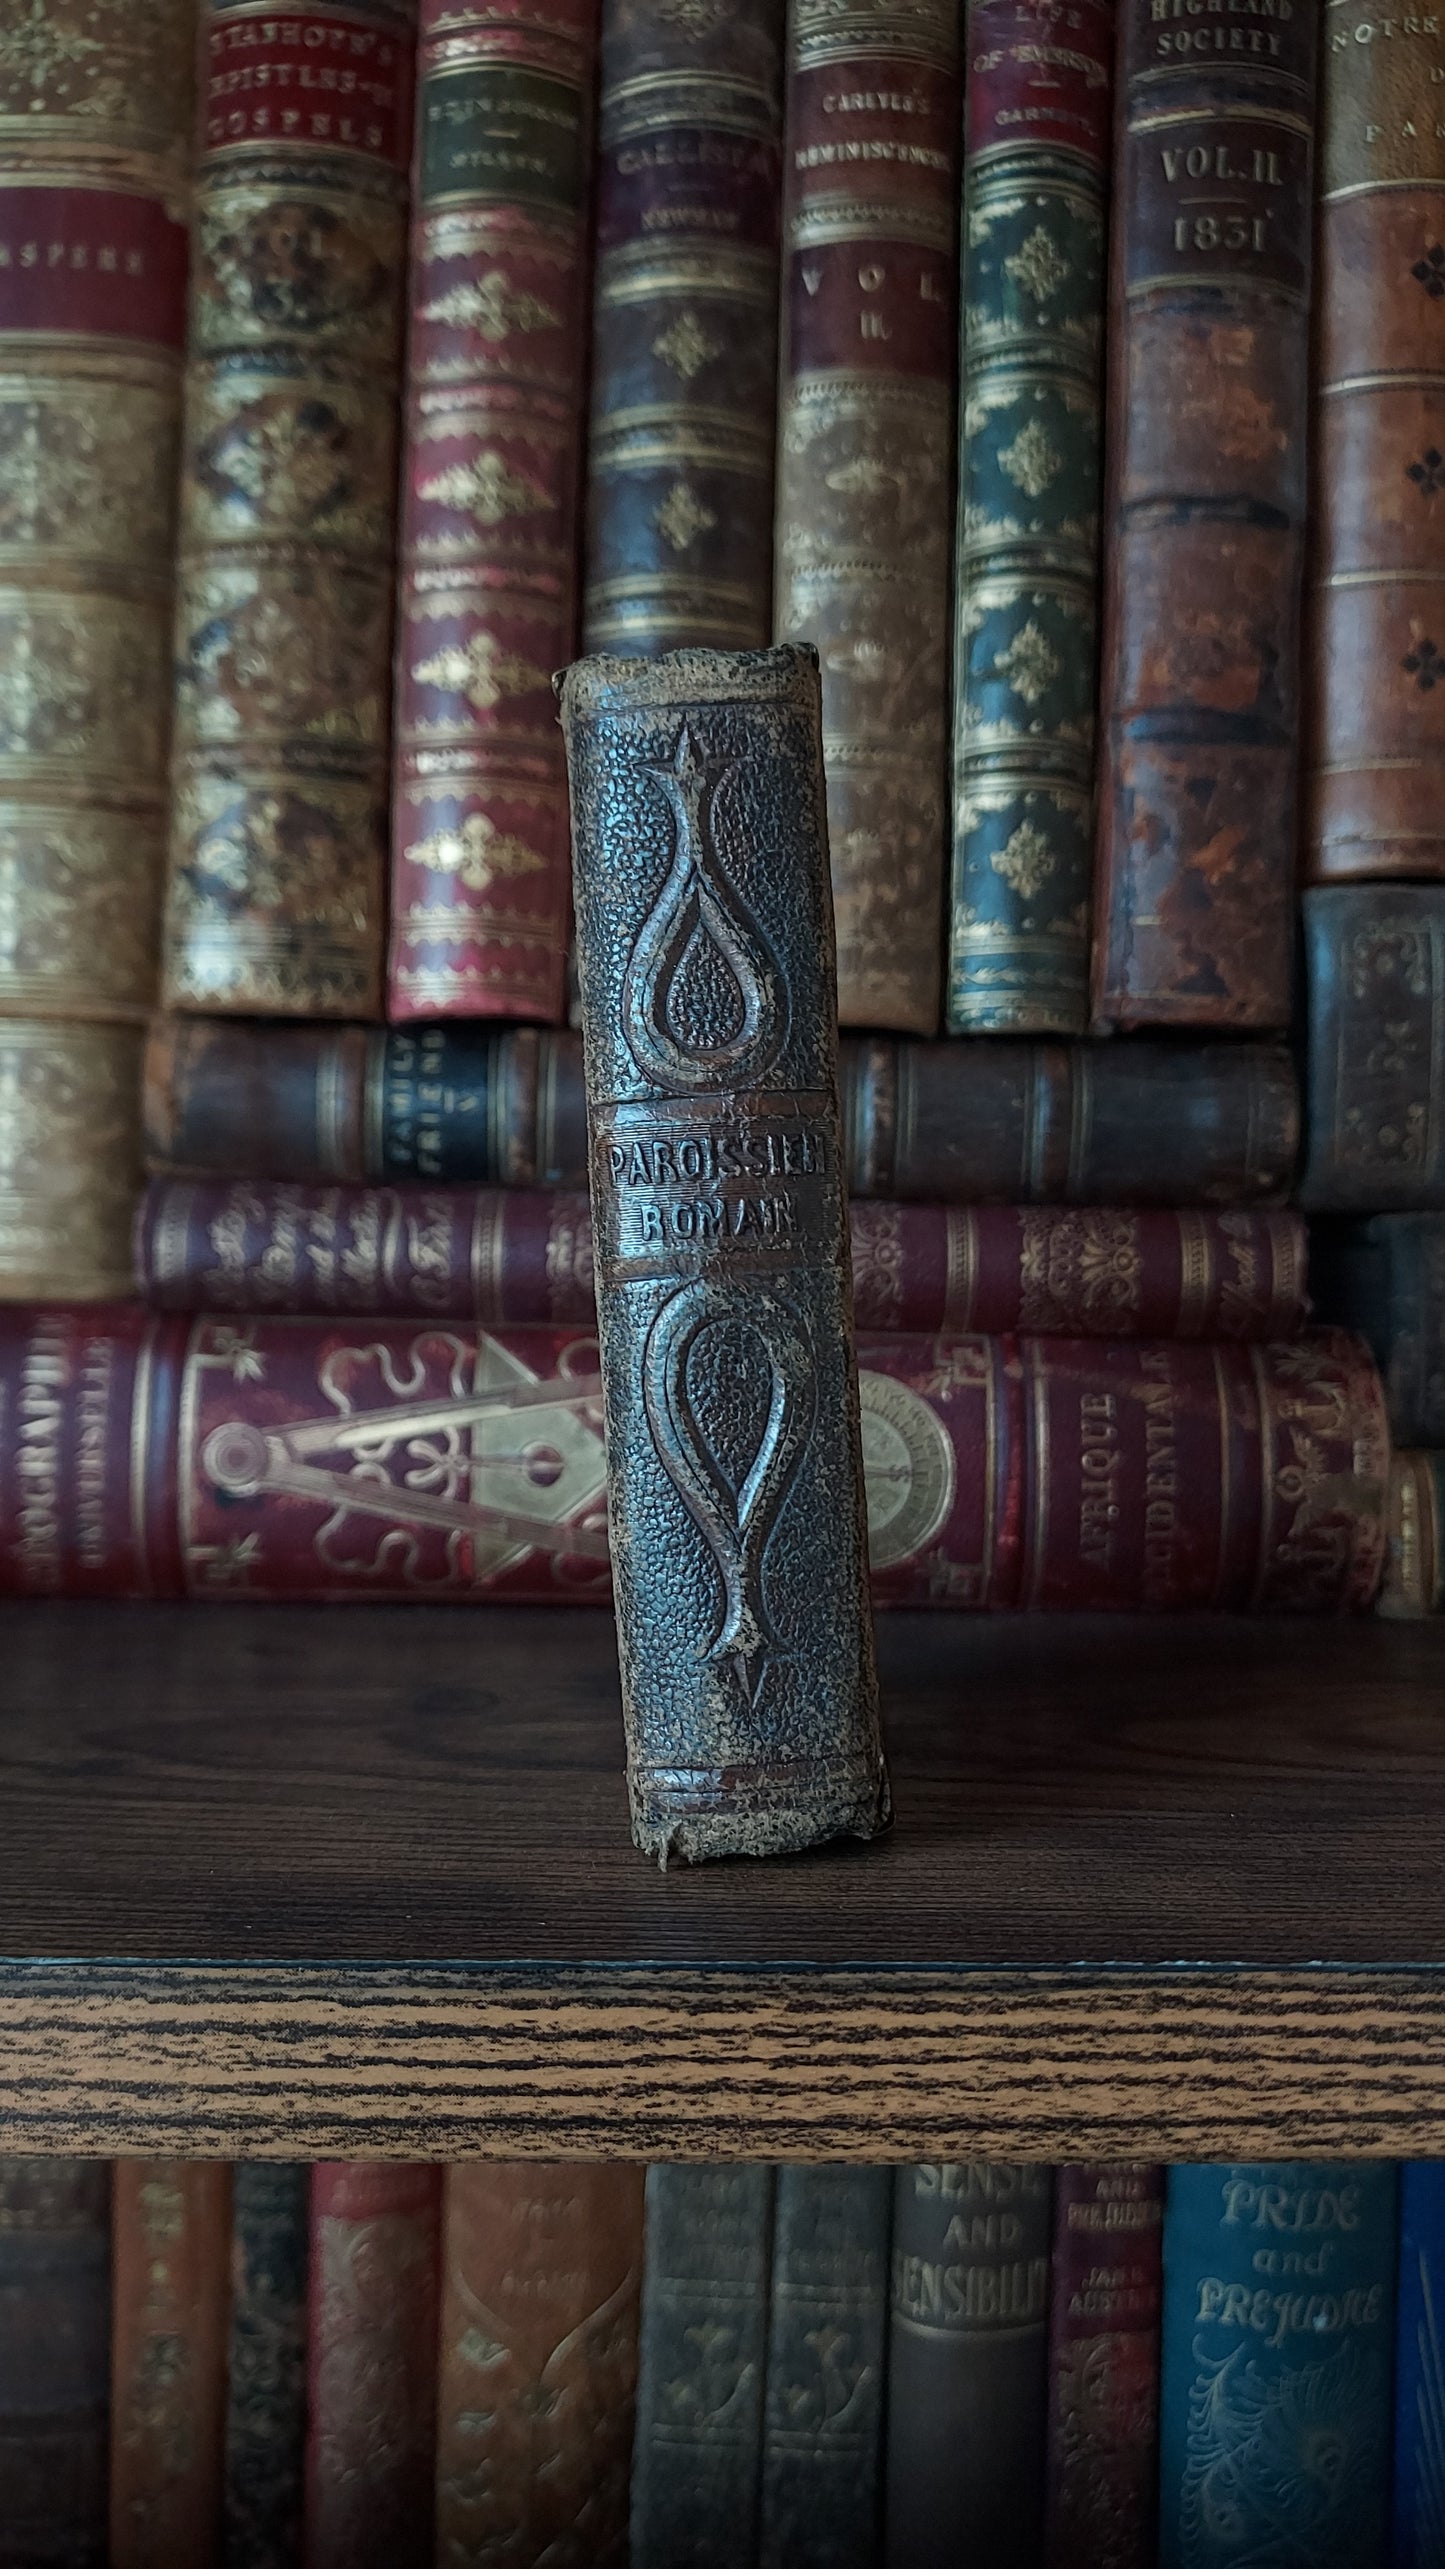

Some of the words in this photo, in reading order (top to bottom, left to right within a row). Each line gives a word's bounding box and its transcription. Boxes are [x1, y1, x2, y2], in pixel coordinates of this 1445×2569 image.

[1156, 26, 1282, 56] SOCIETY
[1331, 15, 1440, 54] NOTRE
[973, 49, 1005, 74] OF
[1174, 216, 1266, 252] 1831
[389, 1034, 416, 1162] FAMILY
[416, 1029, 446, 1173] FRIEND
[610, 1132, 825, 1185] PAROISSIEN
[1079, 1392, 1125, 1571] AFRIQUE
[1219, 2179, 1362, 2232] PRIDE
[942, 2213, 1023, 2250] AND
[1251, 2242, 1336, 2279] and
[1193, 2276, 1386, 2350] PREJUDICE
